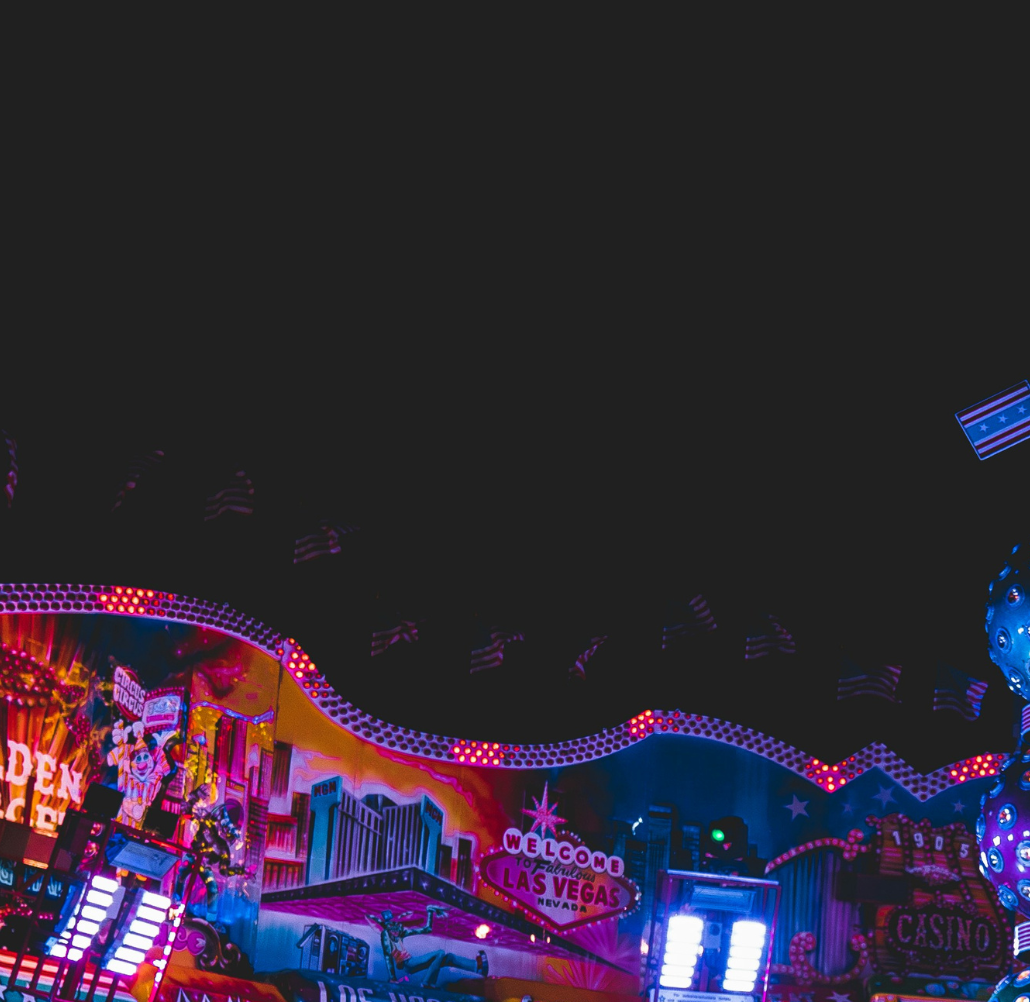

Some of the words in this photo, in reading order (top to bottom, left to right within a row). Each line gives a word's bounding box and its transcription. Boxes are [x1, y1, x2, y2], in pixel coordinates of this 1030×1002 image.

[0, 740, 82, 804] DEN
[313, 780, 337, 797] MGM
[506, 833, 620, 873] WELCOME
[516, 857, 532, 869] TO
[532, 859, 596, 883] Fabulous
[503, 867, 546, 895] LAS
[553, 876, 620, 908] VEGAS
[537, 898, 587, 913] NEVADA
[897, 913, 990, 950] CASINO
